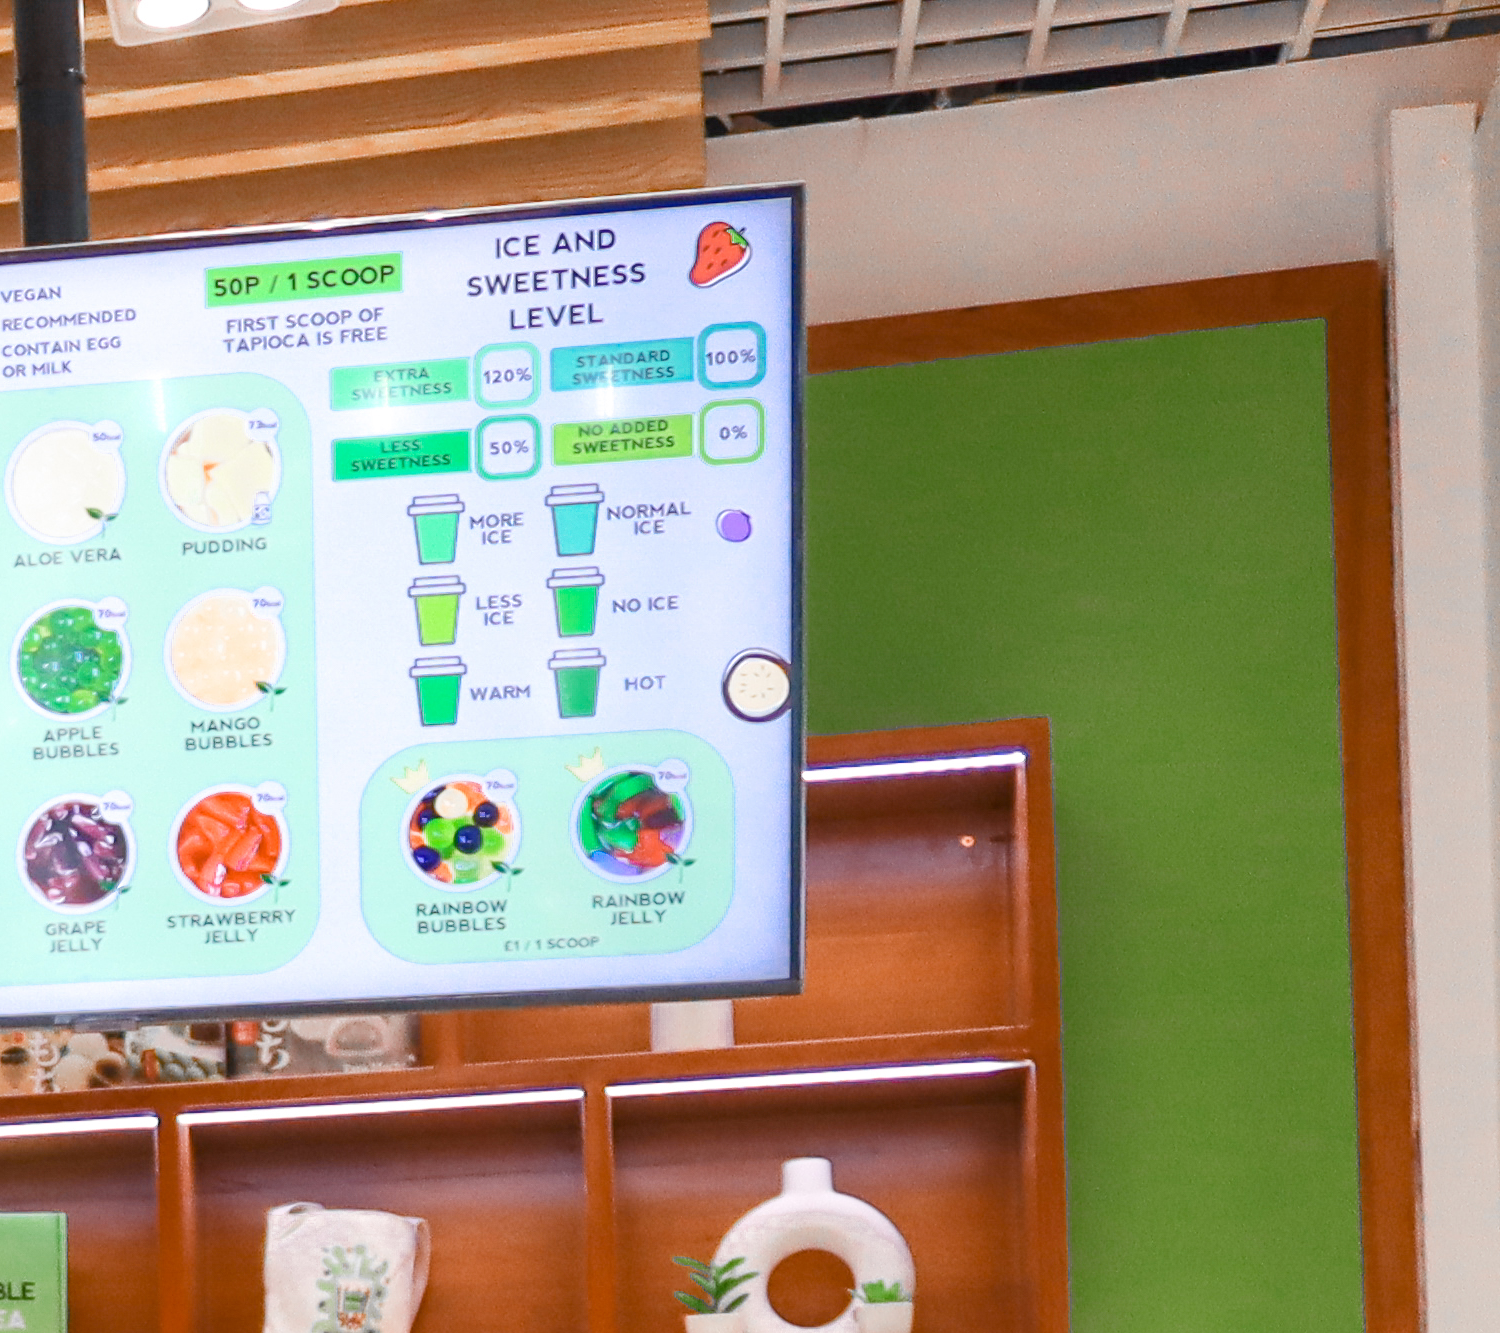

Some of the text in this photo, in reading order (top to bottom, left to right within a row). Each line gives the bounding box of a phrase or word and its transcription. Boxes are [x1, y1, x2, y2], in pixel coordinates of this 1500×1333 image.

[495, 229, 616, 259] ICE AND
[213, 276, 260, 297] 50P
[287, 273, 297, 292] 1
[306, 265, 396, 290] SCOOP
[467, 263, 646, 297] SWEETNESS
[1, 286, 62, 303] VEGAN
[2, 308, 136, 332] RECOMMENDED
[226, 307, 385, 334] FIRST SCOOP OF
[509, 304, 604, 330] LEVEL
[2, 336, 122, 358] CONTAIN EGG
[223, 327, 388, 353] TAPIOCA IS FREE
[706, 350, 756, 366] 100%
[2, 360, 72, 378] OR MILK
[483, 368, 532, 385] 120%
[719, 425, 748, 440] 0%
[489, 440, 529, 455] 50%
[607, 502, 691, 521] NORMAL
[634, 521, 665, 535] ICE
[181, 538, 267, 556] PUDDING
[14, 546, 122, 568] ALOE VERA
[613, 596, 679, 613] NO ICE
[625, 676, 666, 691] HOT
[471, 685, 531, 701] WARM
[592, 892, 686, 909] RAINBOW
[611, 910, 667, 925] JELLY
